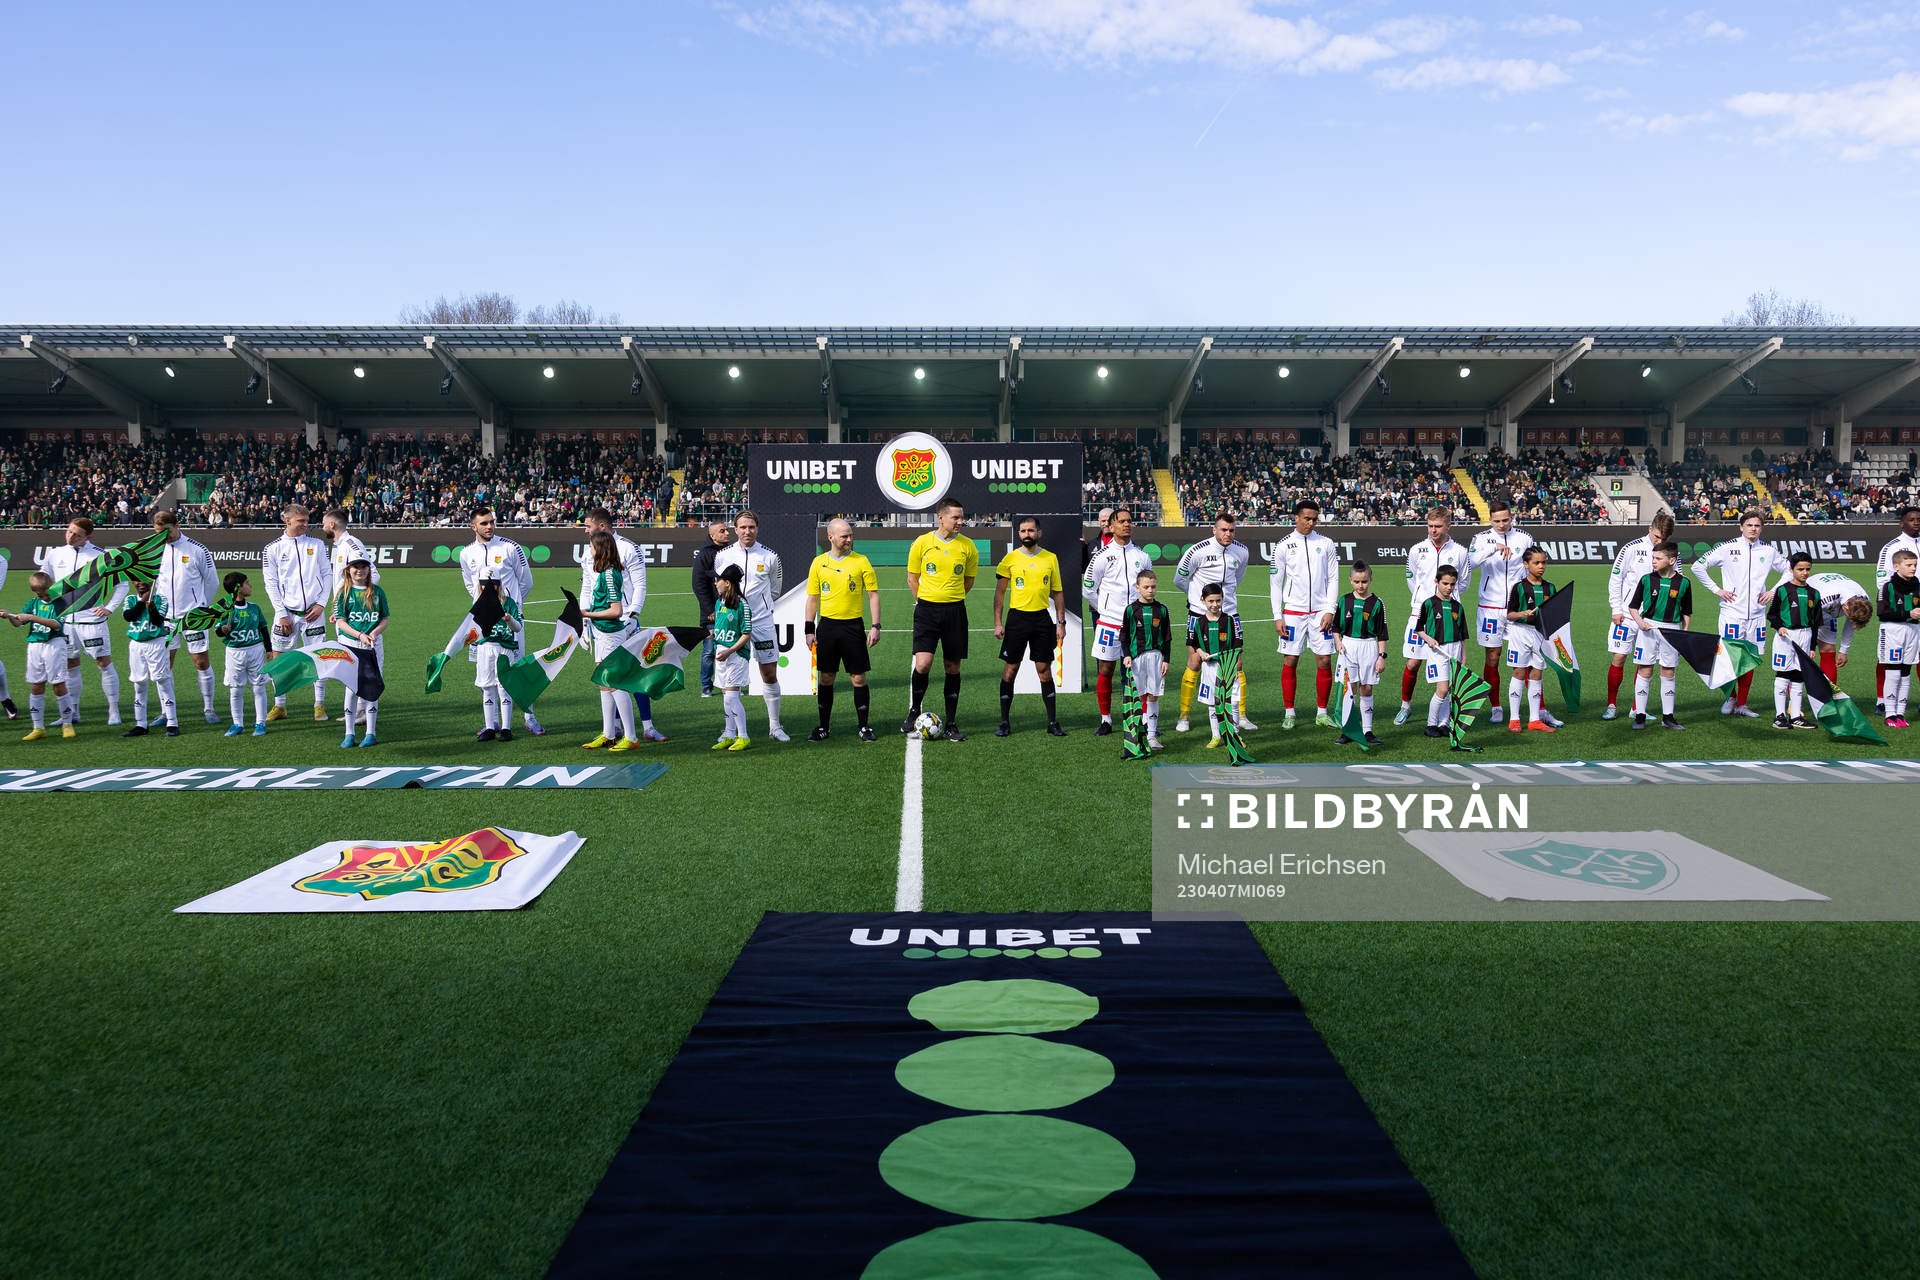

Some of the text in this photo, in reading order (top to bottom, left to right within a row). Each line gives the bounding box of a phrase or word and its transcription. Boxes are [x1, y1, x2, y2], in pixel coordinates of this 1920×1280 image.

[1255, 432, 1297, 440] BRA
[1366, 432, 1458, 440] BRA BRA
[1527, 432, 1568, 440] BRA
[1688, 431, 1780, 439] BRA BRA
[766, 460, 857, 480] UNIBET
[971, 459, 1063, 479] UNIBET
[1613, 482, 1621, 491] D
[1377, 547, 1408, 558] SPELA
[1533, 541, 1617, 560] NIBET
[210, 551, 264, 561] VARSFULL
[348, 611, 379, 622] SSAB
[849, 928, 1152, 947] UNIBET
